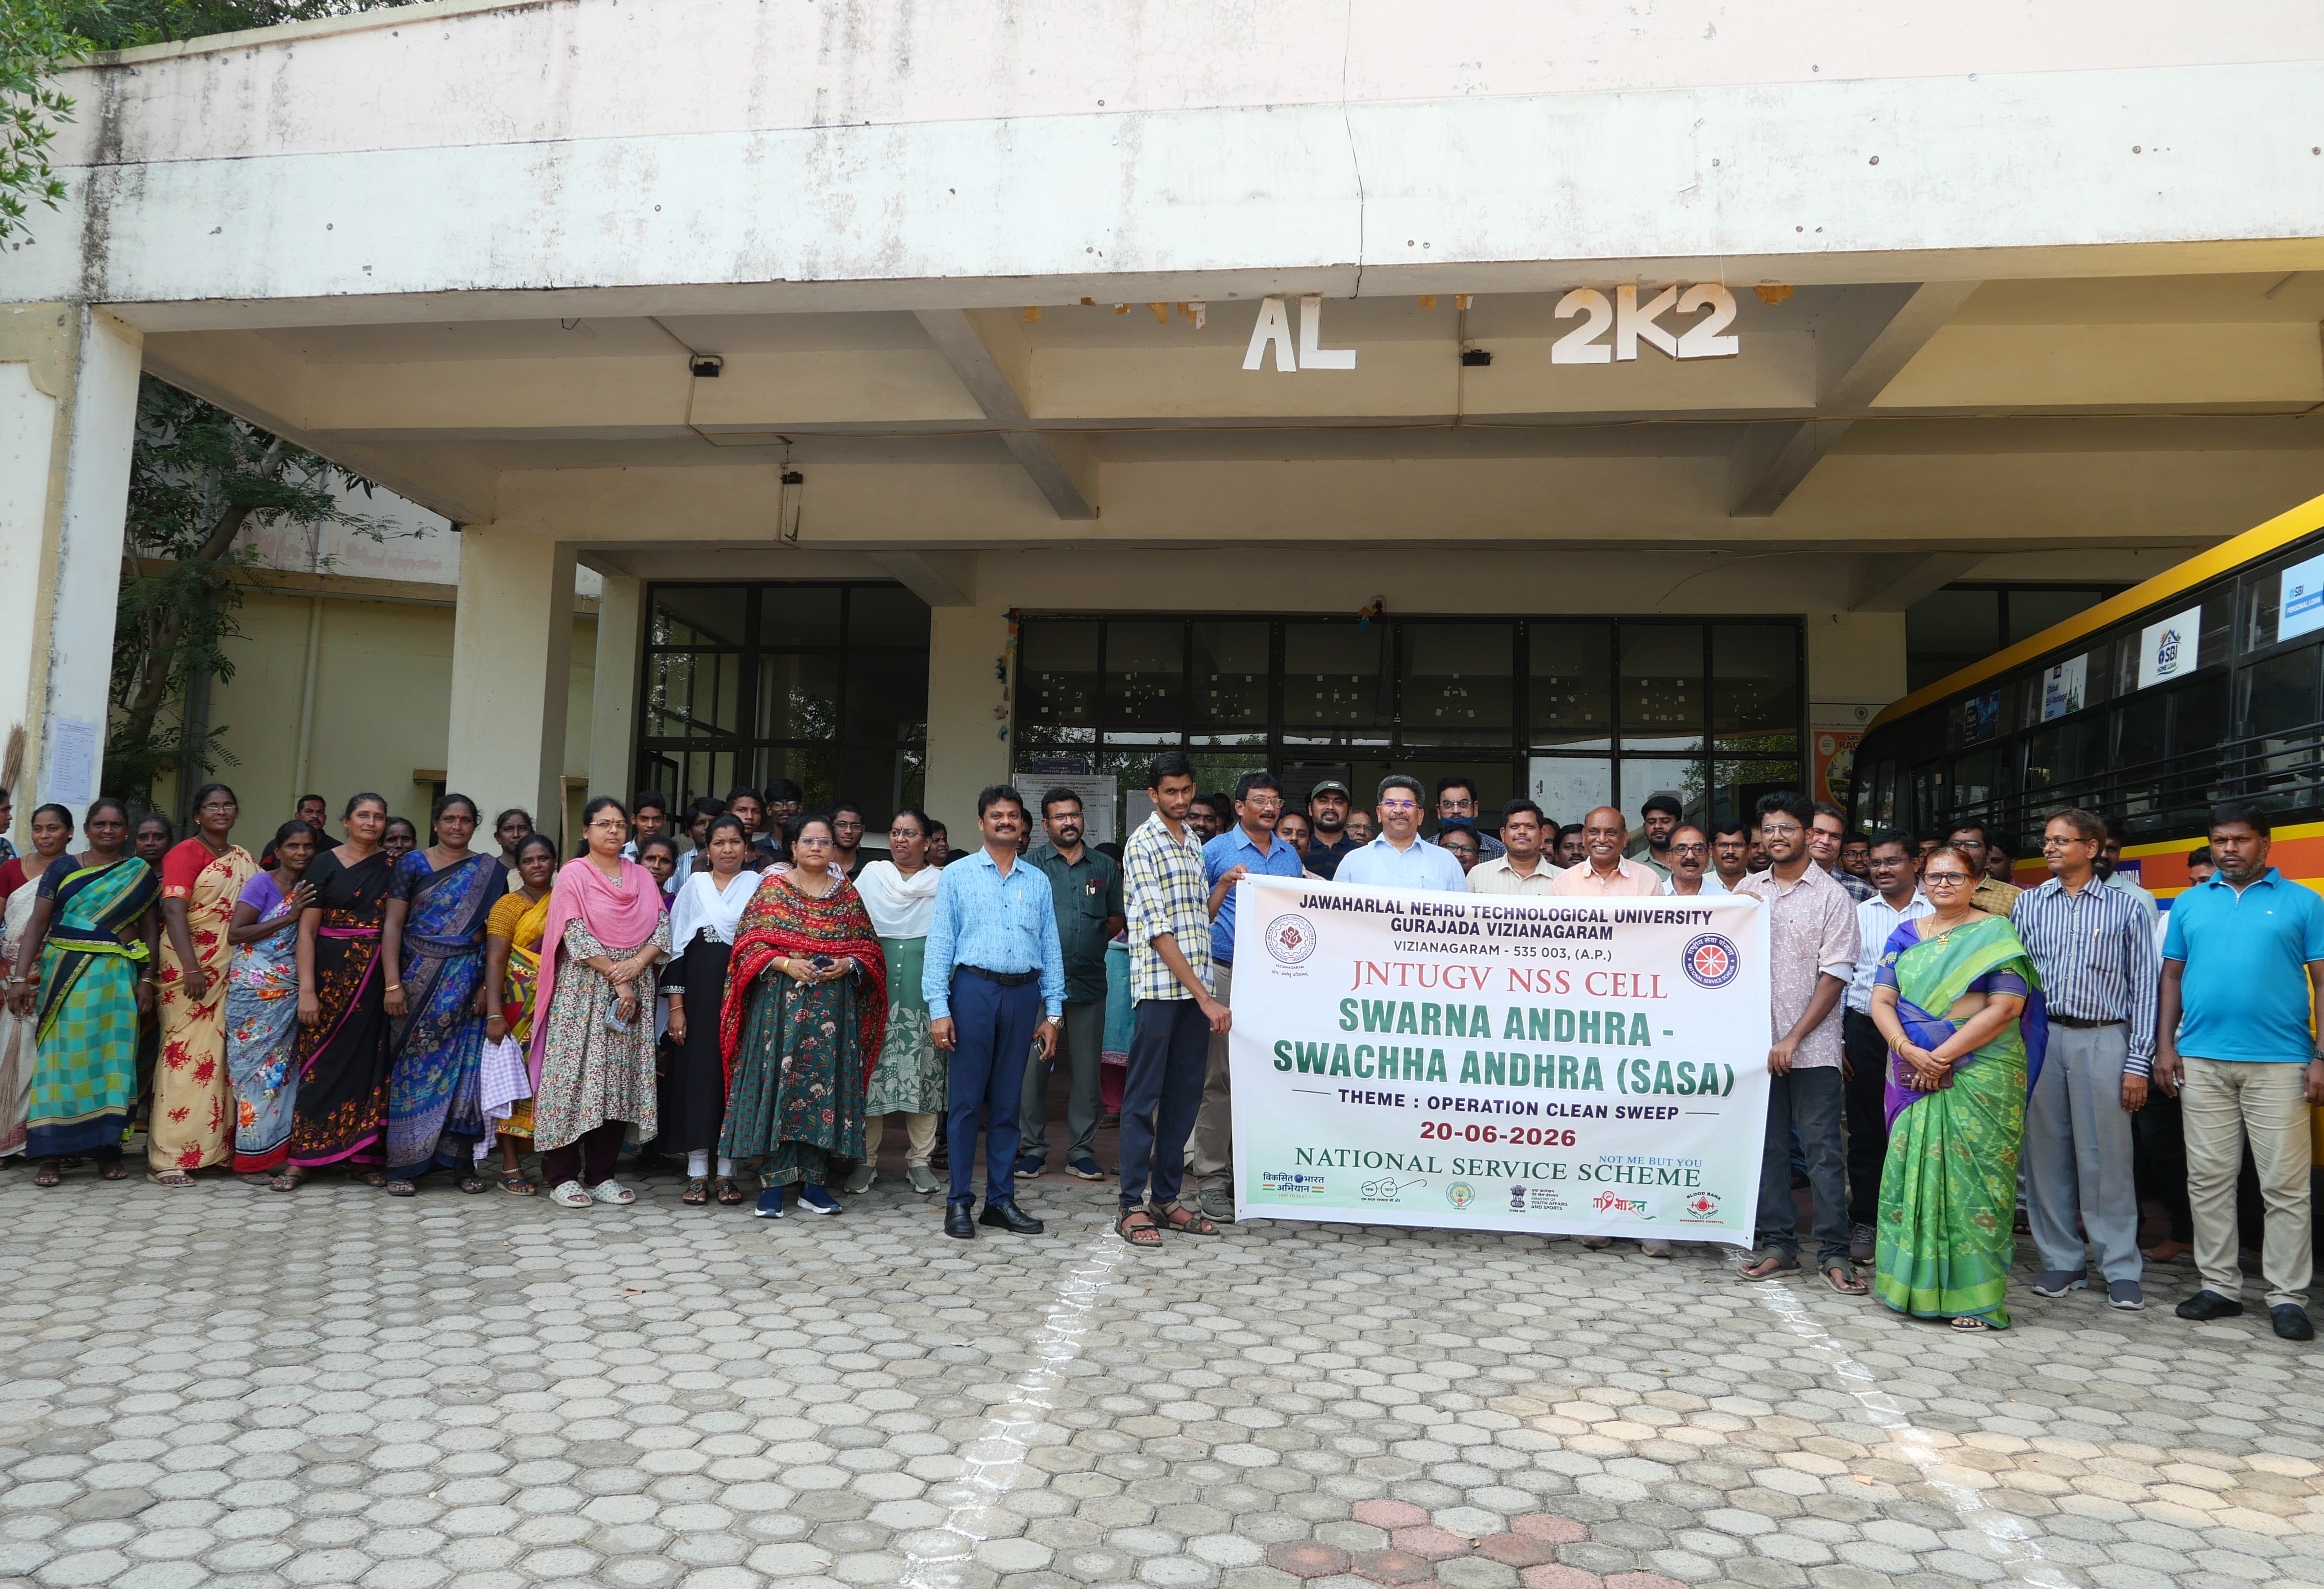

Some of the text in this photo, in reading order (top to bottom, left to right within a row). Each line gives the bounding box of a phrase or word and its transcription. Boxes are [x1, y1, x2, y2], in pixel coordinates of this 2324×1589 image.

[1551, 283, 1738, 363] 2K2
[2294, 584, 2304, 597] SBI
[2287, 596, 2321, 614] PERSONAL LOAN
[2165, 644, 2178, 663] SBI
[2157, 665, 2167, 673] HOME
[2047, 683, 2059, 693] Global
[2045, 710, 2054, 718] Loan
[1299, 894, 1713, 925] JAWAHARLAL NEHRU TECHNOLOGICAL UNIVERSITY
[1273, 916, 1305, 925] TECHNOLOGICAL
[1391, 918, 1613, 940] GURAJADA VIZIANAGARAM
[1393, 941, 1499, 955] VIZIANAGARAM
[1513, 946, 1537, 957] 535
[1542, 947, 1570, 961] 003,
[1575, 948, 1612, 962] (A.P.)
[1719, 939, 1735, 955] योजना
[1350, 960, 1668, 999] JNTUGV NSS CELL
[1687, 963, 1702, 982] NATIONAL
[1722, 965, 1735, 981] SCHEME
[1338, 997, 1492, 1039] SWARNA
[1503, 1007, 1651, 1047] ANDHRA
[1273, 1040, 1735, 1097] SWACHHA ANDHRA (SASA)
[1338, 1089, 1405, 1107] THEME
[1427, 1096, 1539, 1116] OPERATION
[1546, 1102, 1607, 1118] CLEAN
[1615, 1105, 1679, 1120] SWEEP
[1420, 1121, 1576, 1147] 20-06-2026
[1294, 1147, 1701, 1187] NATIONAL SERVICE SCHEME
[1598, 1155, 1703, 1167] NOT ME BUT YOU
[1262, 1172, 1293, 1181] विकसित
[1277, 1182, 1309, 1192] अभियान
[1707, 1192, 1722, 1201] BANK
[1614, 1198, 1653, 1218] भारत
